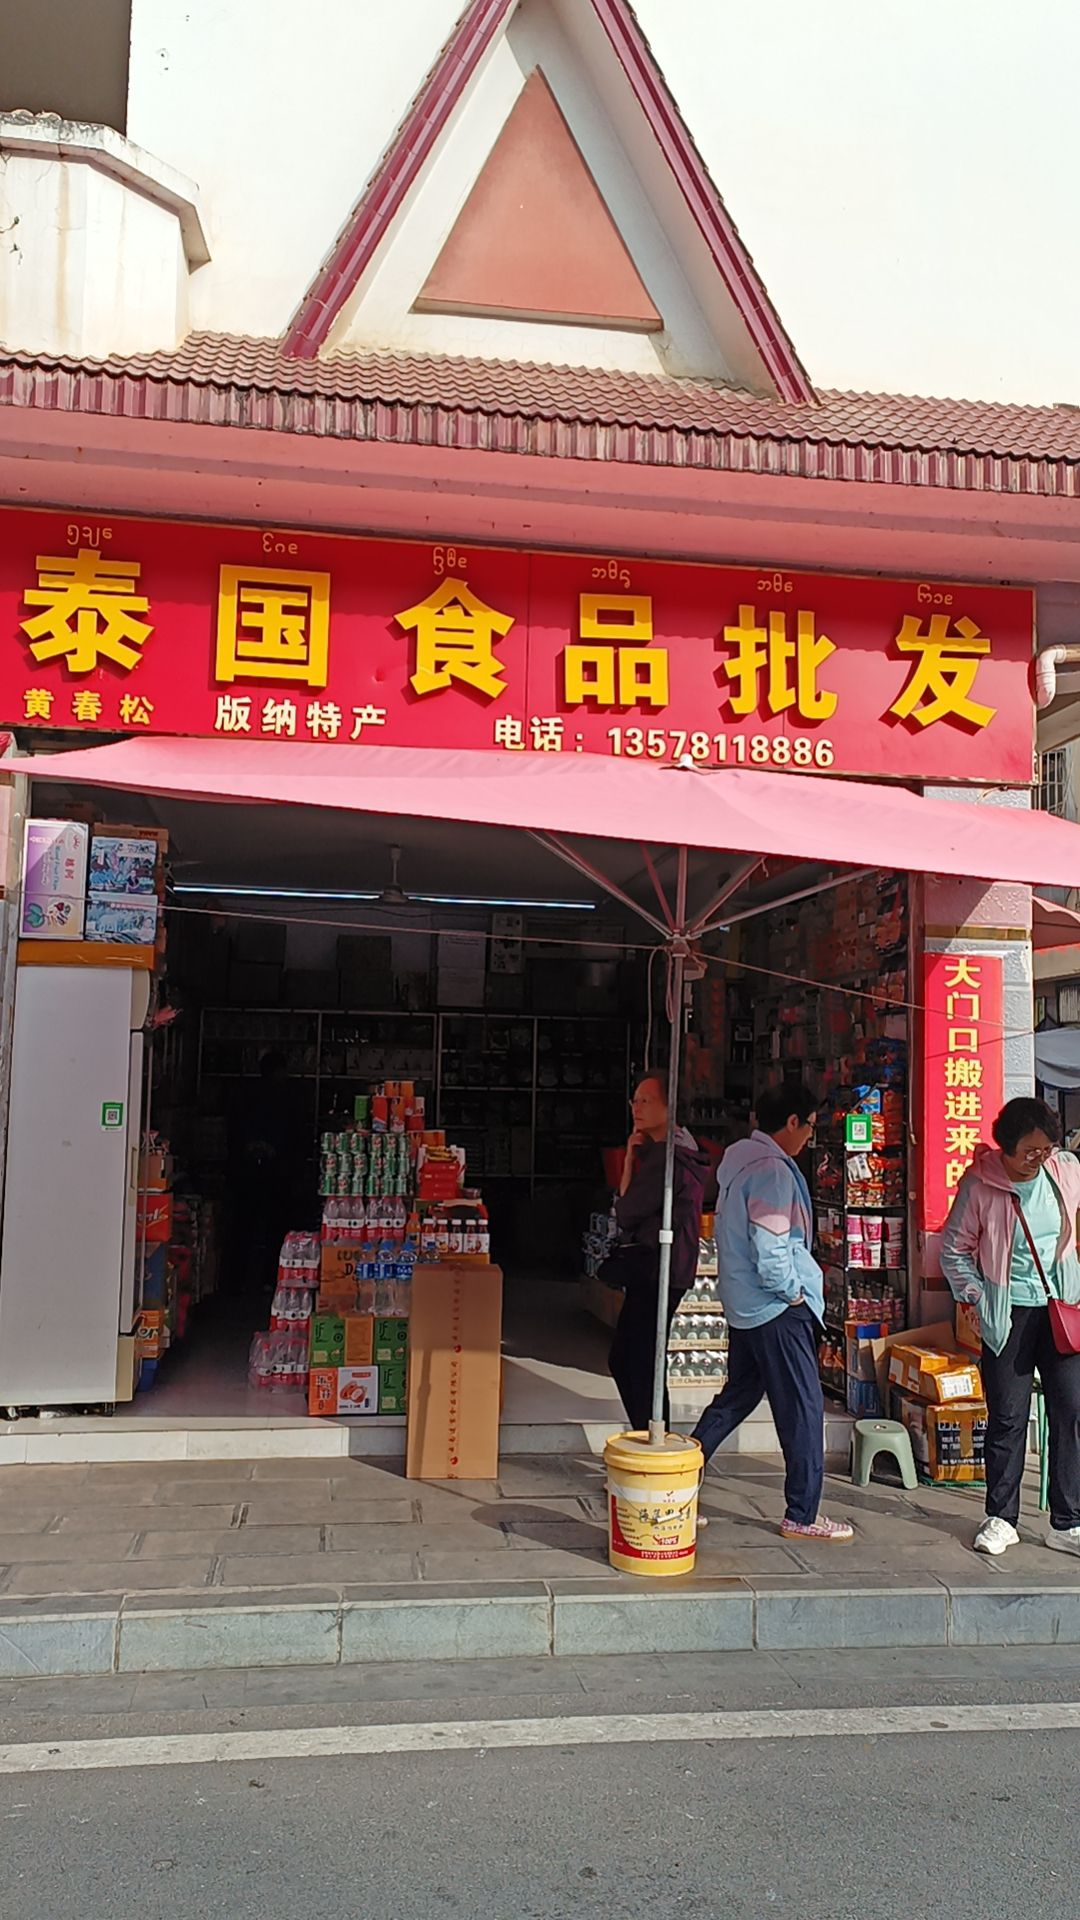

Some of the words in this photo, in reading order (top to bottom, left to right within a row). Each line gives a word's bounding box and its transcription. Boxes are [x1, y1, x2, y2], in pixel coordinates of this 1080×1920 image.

[19, 548, 998, 728] 泰国食品批发
[23, 688, 154, 725] 黄春松
[214, 694, 388, 740] 版纳特产
[607, 727, 835, 767] 13578118886
